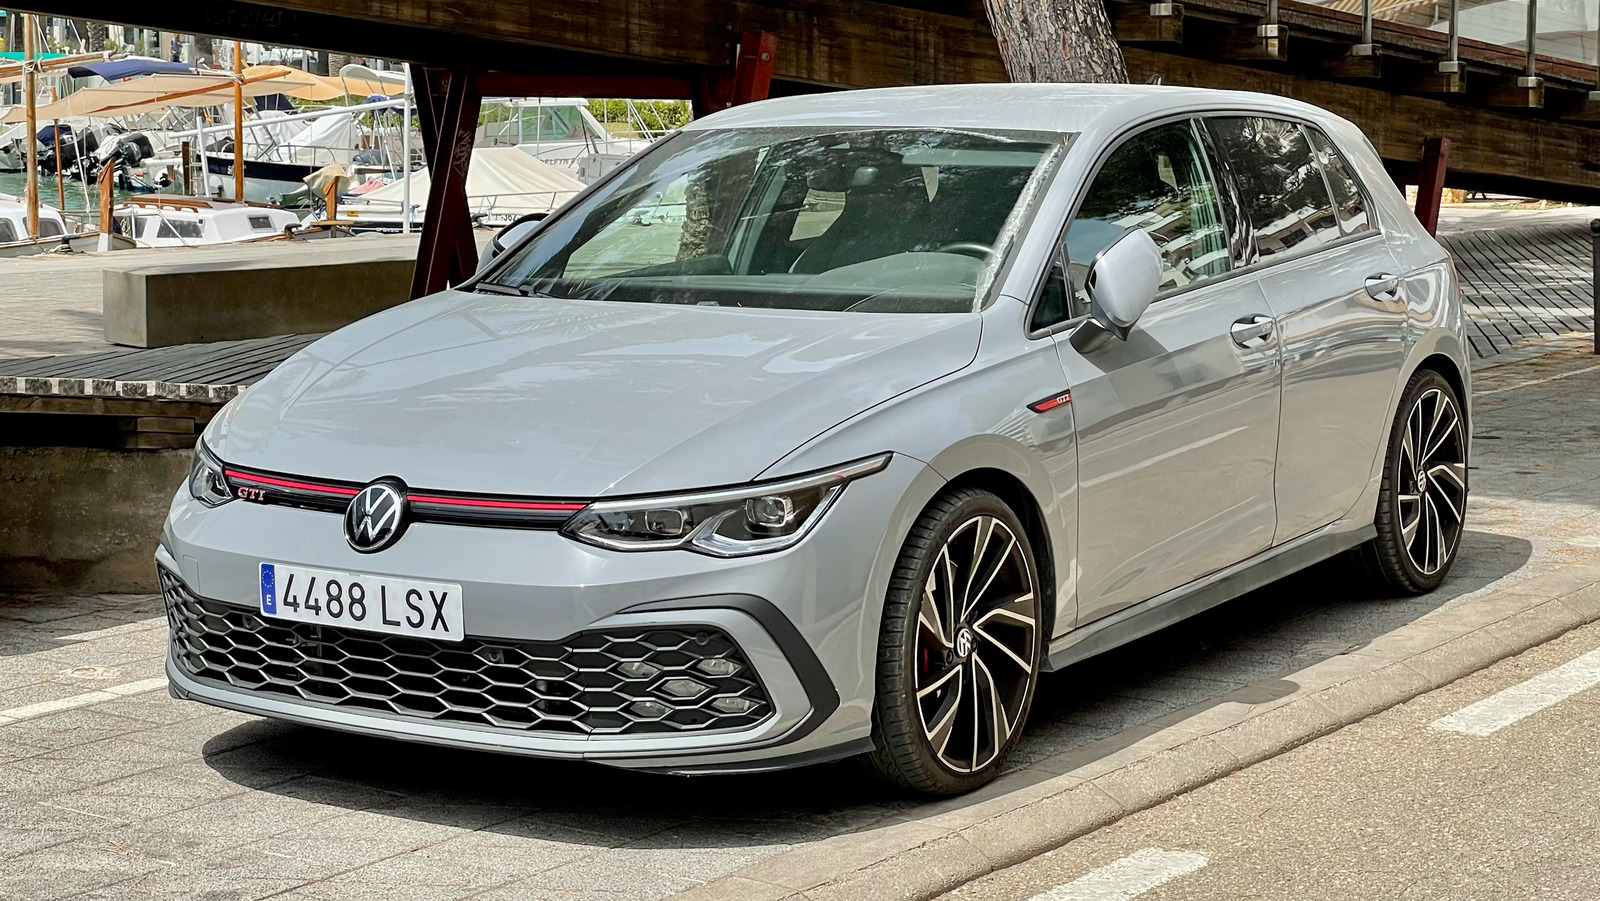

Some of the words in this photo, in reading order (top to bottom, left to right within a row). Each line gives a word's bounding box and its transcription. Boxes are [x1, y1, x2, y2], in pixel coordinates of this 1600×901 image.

[1056, 394, 1070, 404] GTI
[238, 486, 265, 500] GTI
[266, 594, 272, 606] E
[283, 573, 367, 622] 4488
[380, 585, 450, 633] LSX
